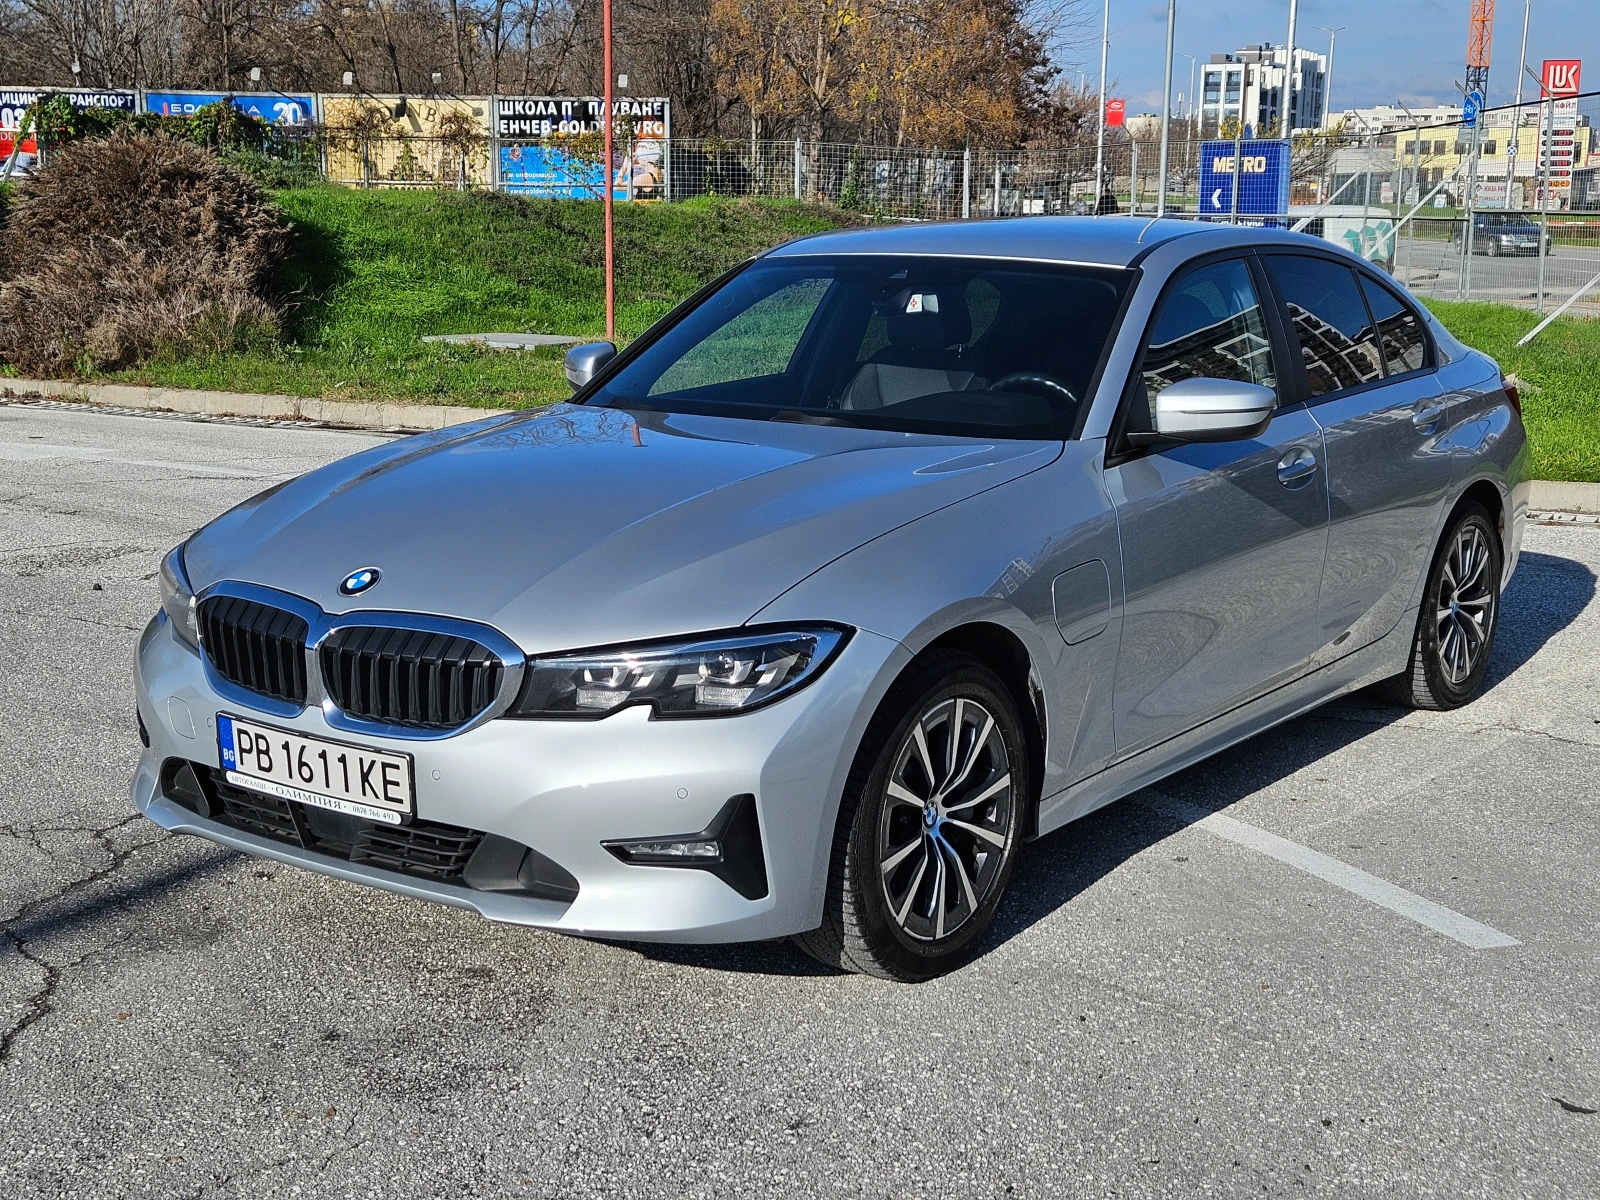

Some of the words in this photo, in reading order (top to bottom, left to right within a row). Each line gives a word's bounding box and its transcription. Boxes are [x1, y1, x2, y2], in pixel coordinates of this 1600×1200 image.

[500, 101, 557, 115] ШКОЛА
[1213, 156, 1267, 173] MERO
[223, 748, 234, 762] BG
[236, 727, 273, 773] PB
[281, 740, 350, 794] 1611
[359, 756, 404, 805] KE
[275, 785, 342, 810] ОЛИМПИЯ
